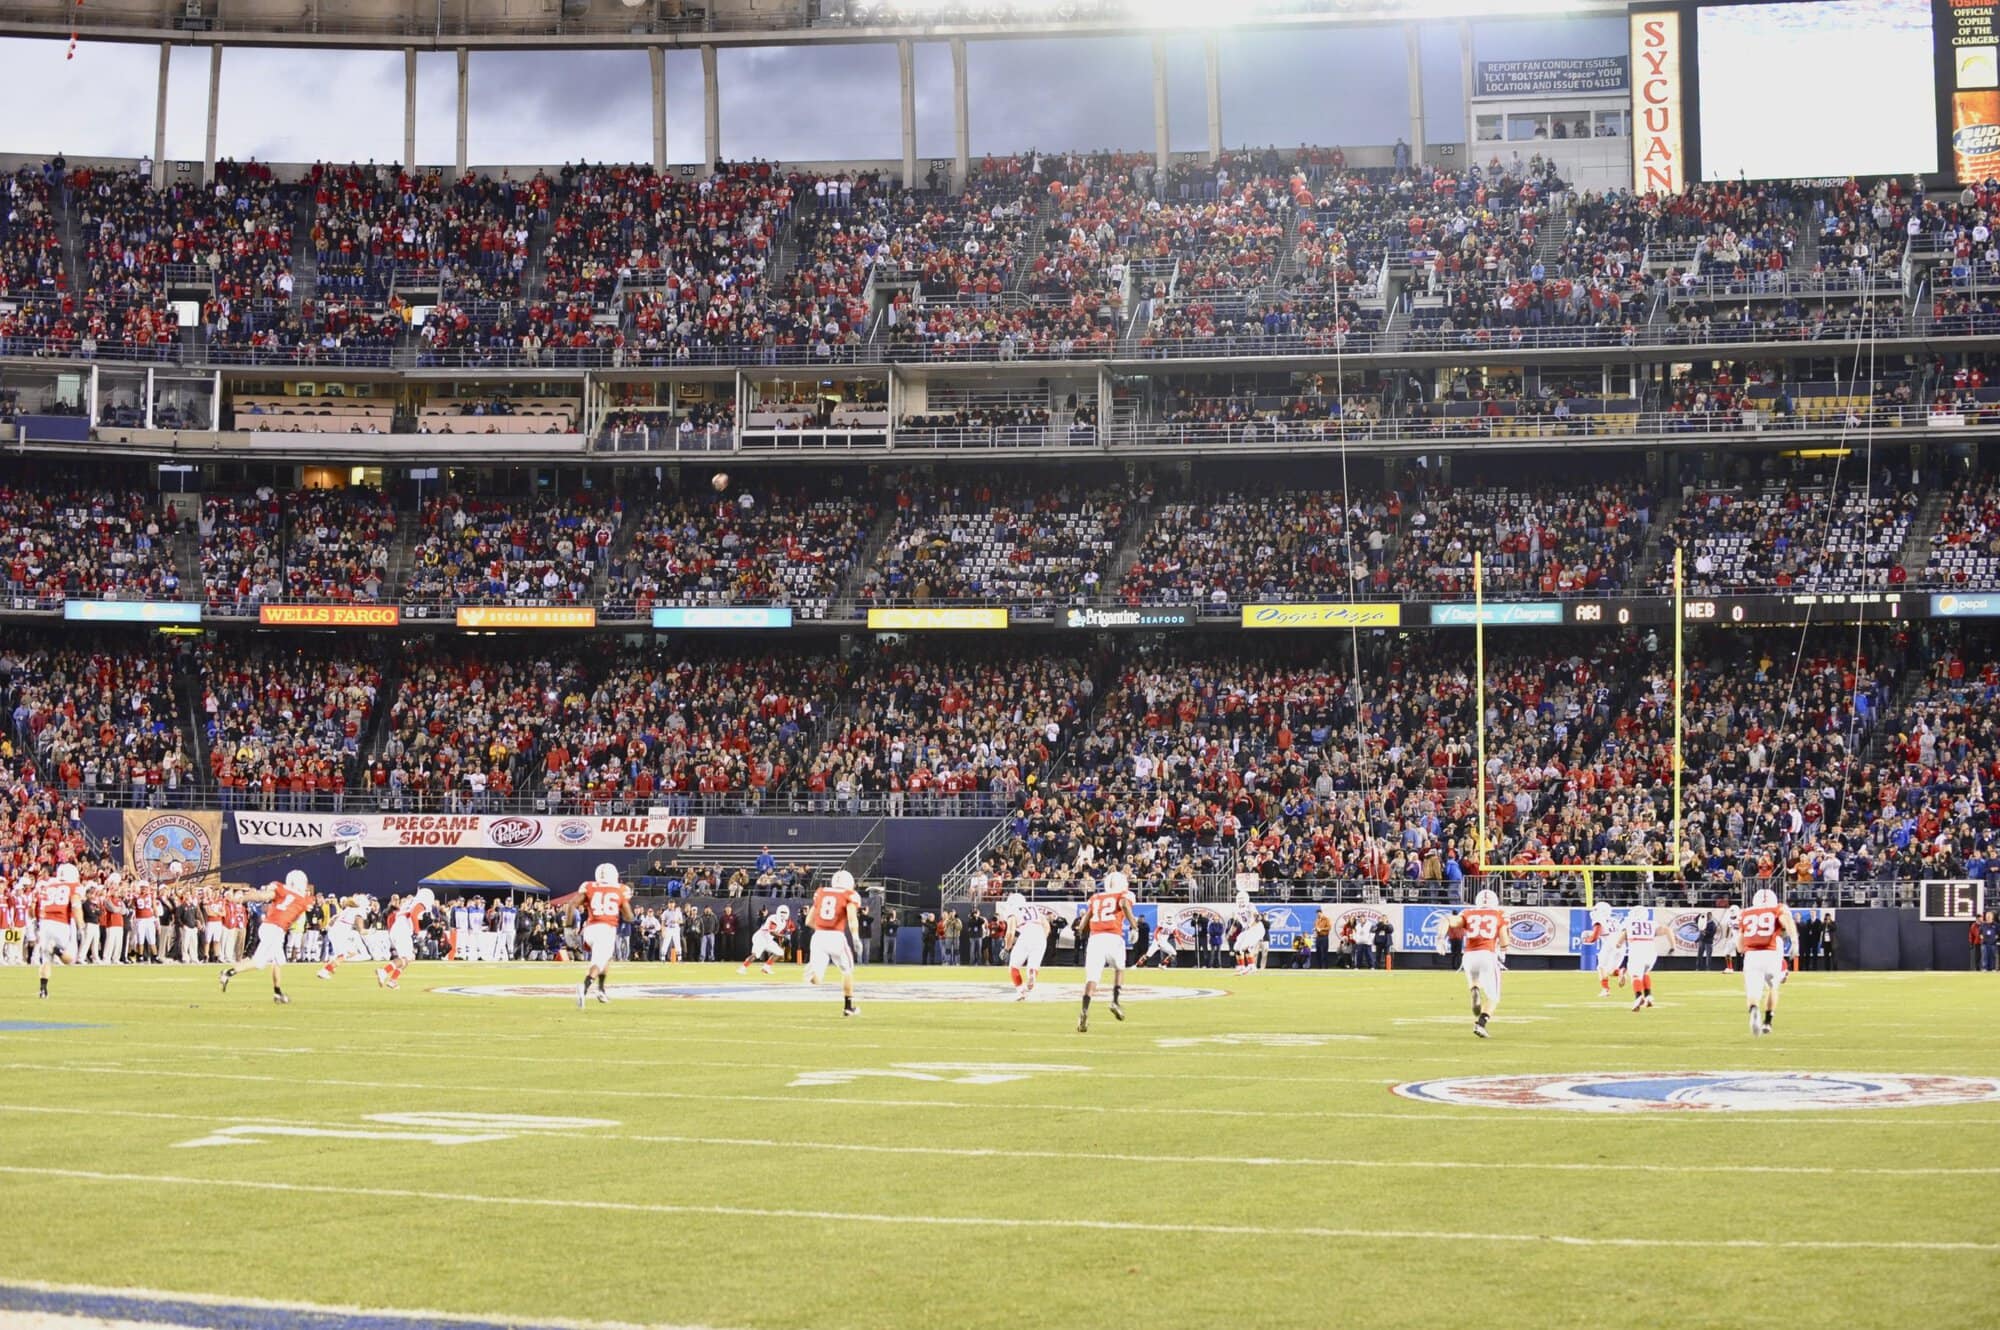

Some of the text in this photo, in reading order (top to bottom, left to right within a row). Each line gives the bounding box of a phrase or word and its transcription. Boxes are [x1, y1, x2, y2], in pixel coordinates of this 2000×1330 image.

[1954, 8, 1994, 16] OFFICIAL
[1958, 26, 1992, 35] OF THE
[1952, 36, 2000, 45] CHARGERS
[1488, 62, 1522, 72] REPORT
[1523, 61, 1540, 70] FAN
[1542, 60, 1584, 70] CONDUCT
[1484, 72, 1506, 82] TEXT
[1598, 68, 1622, 77] YOUR
[1486, 82, 1530, 92] LOCATION
[1532, 80, 1552, 90] AND
[1554, 80, 1579, 88] ISSUE
[1582, 80, 1593, 88] TO
[1594, 78, 1621, 88] 41513
[1642, 21, 1672, 191] SYCUAN
[1961, 126, 2000, 139] BUD
[265, 608, 396, 622] WELLS FARGO
[1086, 608, 1140, 628] Brigantine
[1618, 608, 1629, 624] 0
[1732, 606, 1743, 621] 0
[142, 817, 203, 838] SYCUAN BAND
[240, 820, 322, 838] SYCUAN
[382, 816, 480, 831] PREGAME
[508, 822, 523, 832] Dr
[398, 831, 463, 846] SHOW
[497, 824, 532, 843] Pepper
[624, 833, 688, 848] SHOW
[276, 894, 296, 911] 1
[590, 892, 619, 916] 46
[1944, 884, 1973, 916] 16
[820, 896, 836, 920] 8
[1090, 898, 1116, 922] 12
[1466, 914, 1497, 939] 33
[1632, 922, 1652, 936] 39
[1742, 912, 1775, 938] 39
[168, 1111, 624, 1148] 10
